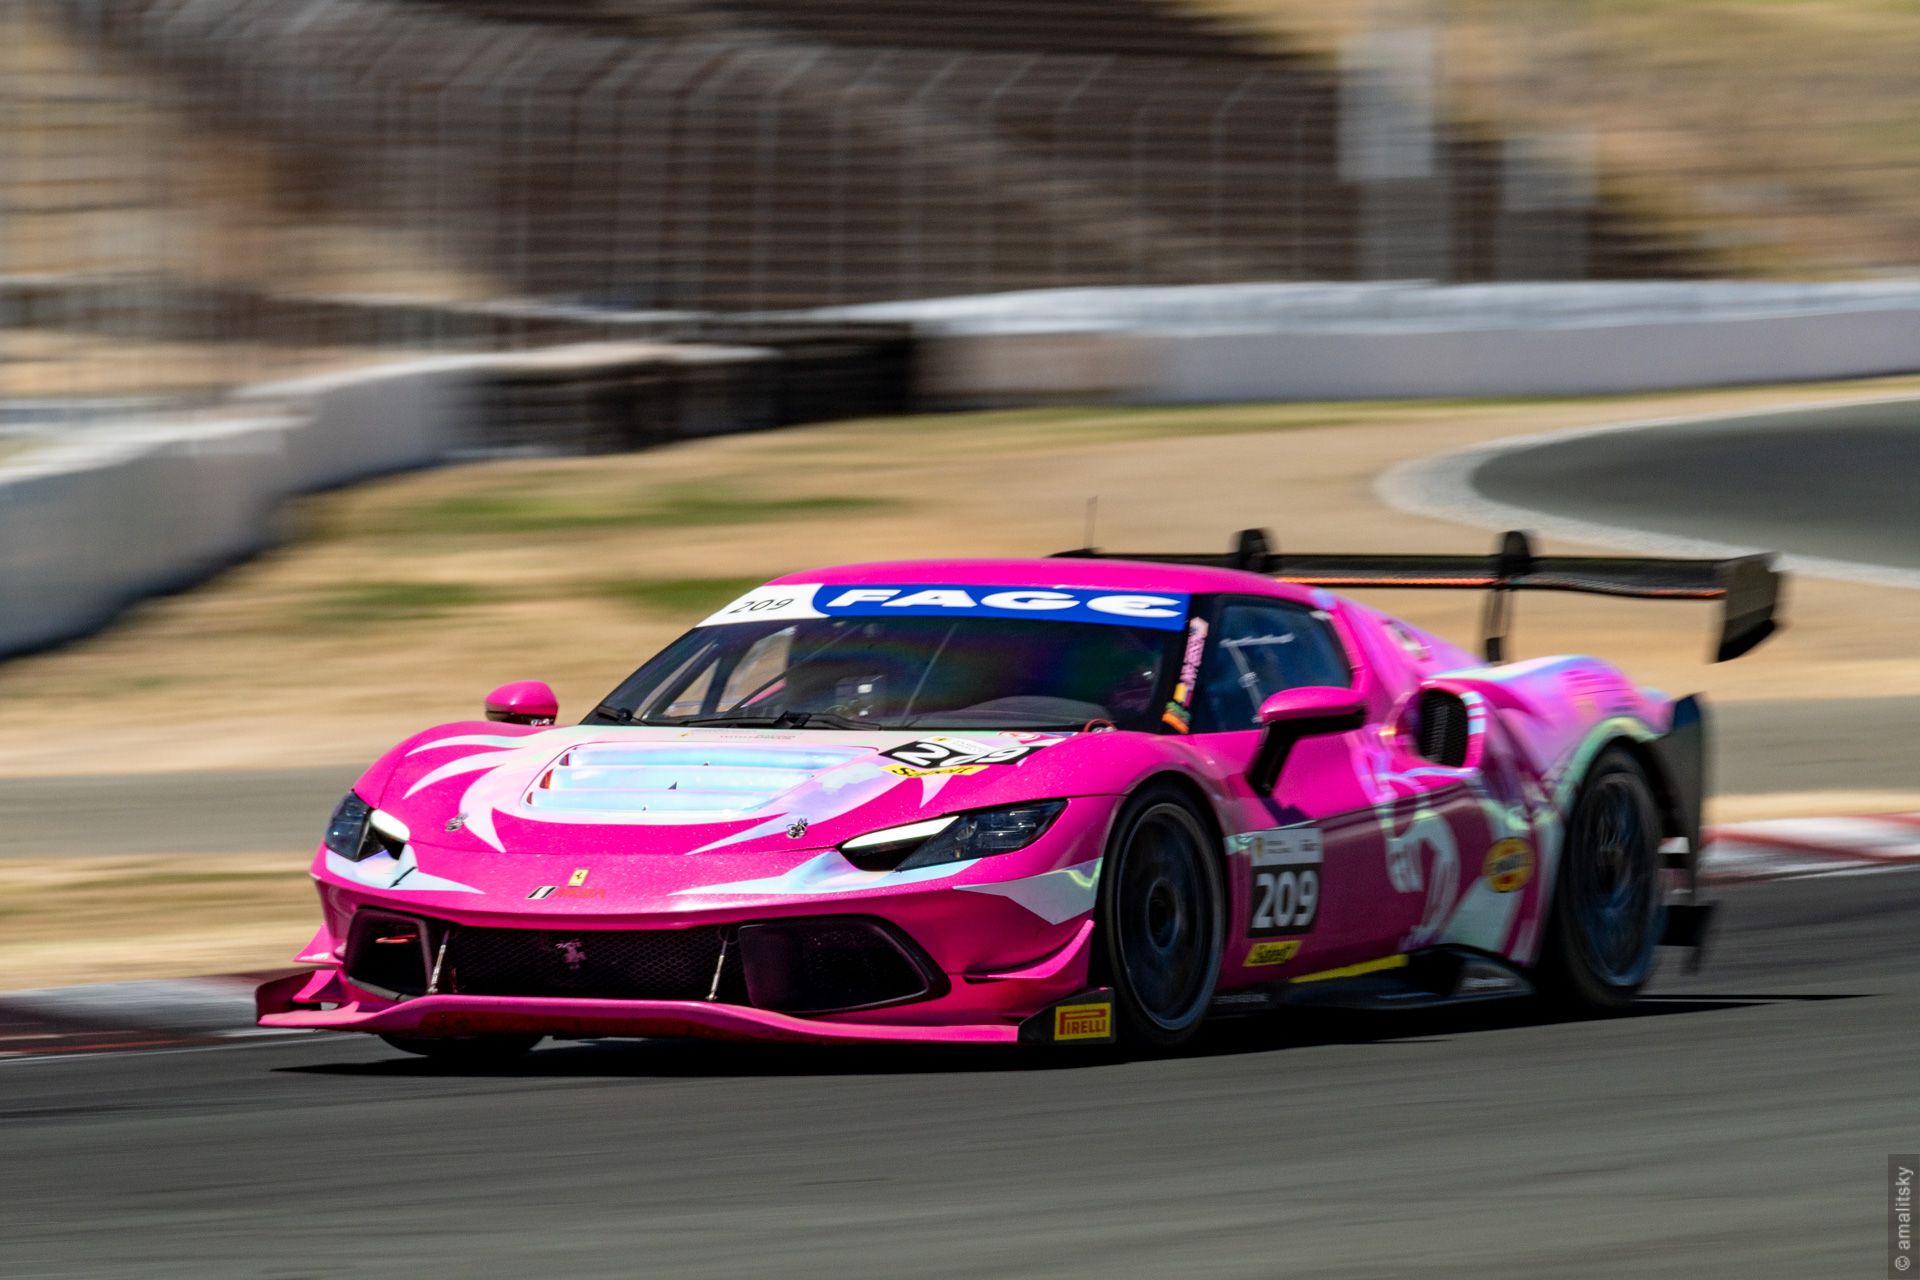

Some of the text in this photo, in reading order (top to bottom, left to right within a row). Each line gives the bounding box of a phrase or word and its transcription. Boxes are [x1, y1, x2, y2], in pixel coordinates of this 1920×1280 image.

[728, 598, 795, 614] 209
[825, 589, 1183, 618] FAGE
[1251, 869, 1319, 929] 209
[1059, 1009, 1107, 1035] PIRELLI
